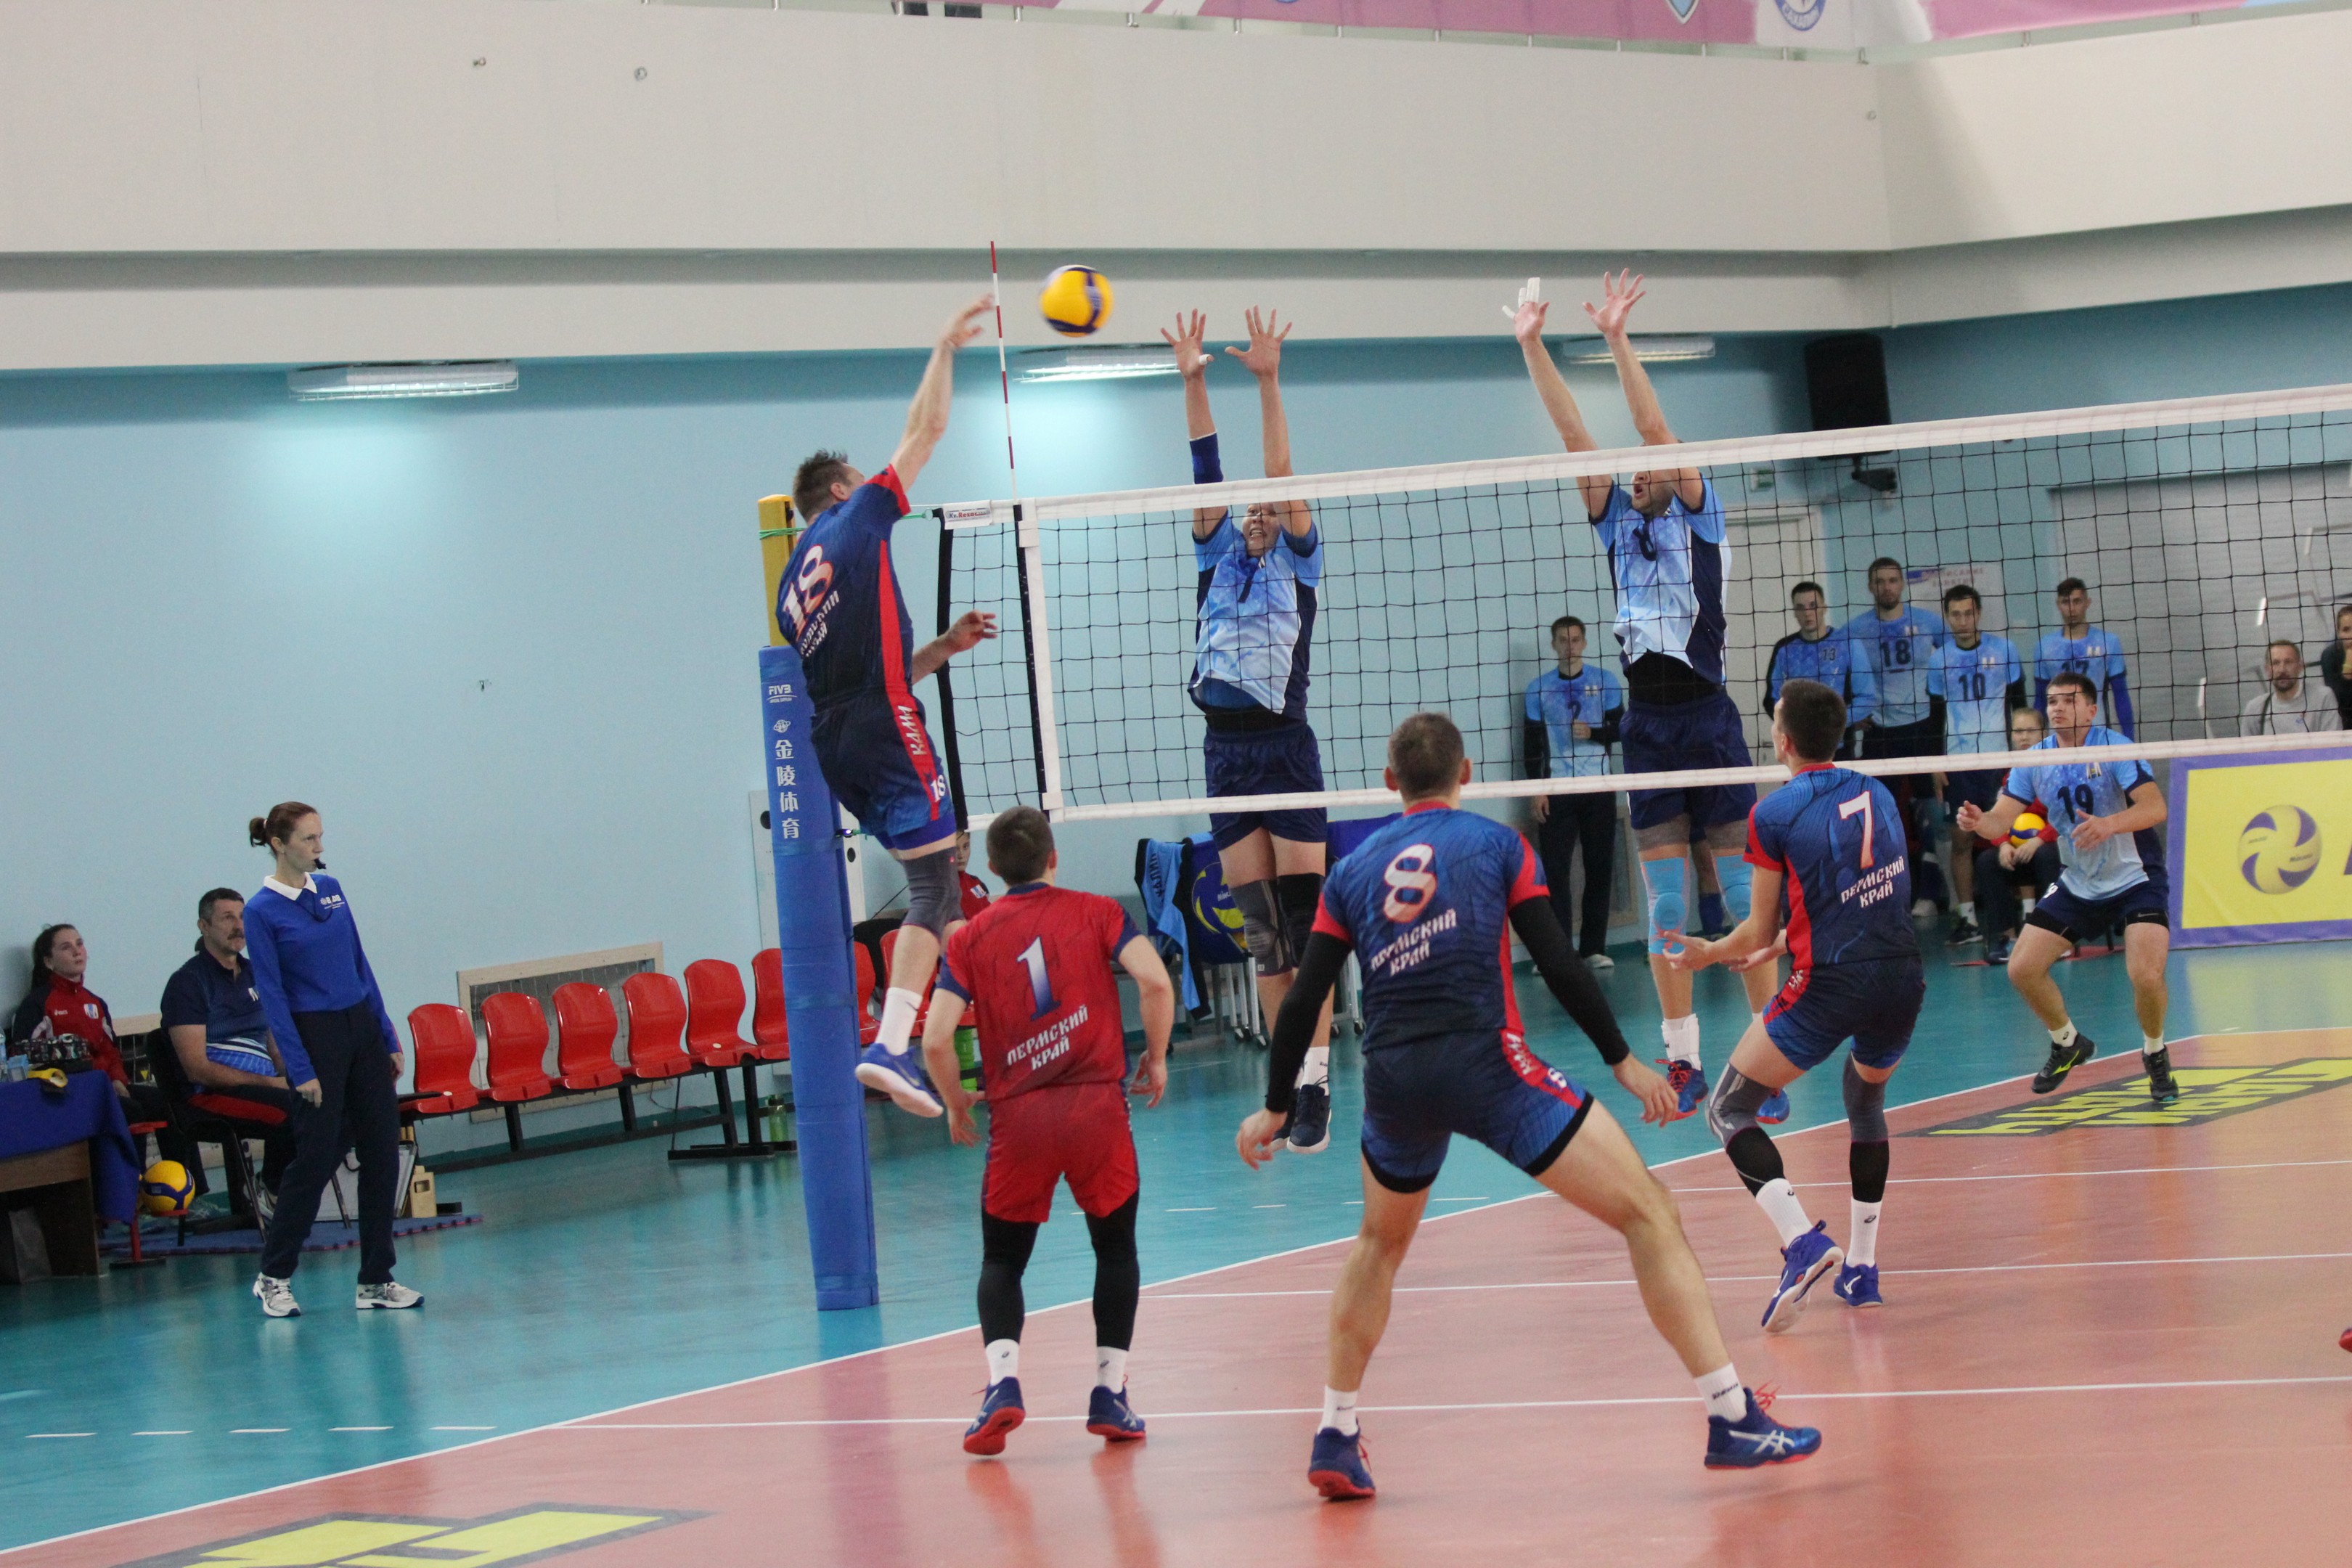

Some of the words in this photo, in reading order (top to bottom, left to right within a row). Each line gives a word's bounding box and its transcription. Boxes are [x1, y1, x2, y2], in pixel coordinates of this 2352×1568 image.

[783, 544, 834, 642] 18
[1881, 639, 1911, 667] 18
[768, 684, 792, 695] FIVB
[1959, 672, 1986, 702] 10
[775, 739, 800, 839] 金陵体育
[930, 774, 946, 803] 18
[2057, 783, 2094, 823] 19
[1838, 790, 1874, 870] 7
[1384, 842, 1438, 923] 8
[1840, 855, 1905, 905] ПЕРМСКИЙ
[1859, 878, 1894, 908] КРАЙ
[1370, 907, 1458, 973] ПЕРМСКИЙ
[1389, 942, 1430, 977] КРАЙ
[1016, 935, 1062, 1022] 1
[1007, 1003, 1089, 1066] ПЕРМСКИЙ
[1031, 1037, 1070, 1071] КРАЙ
